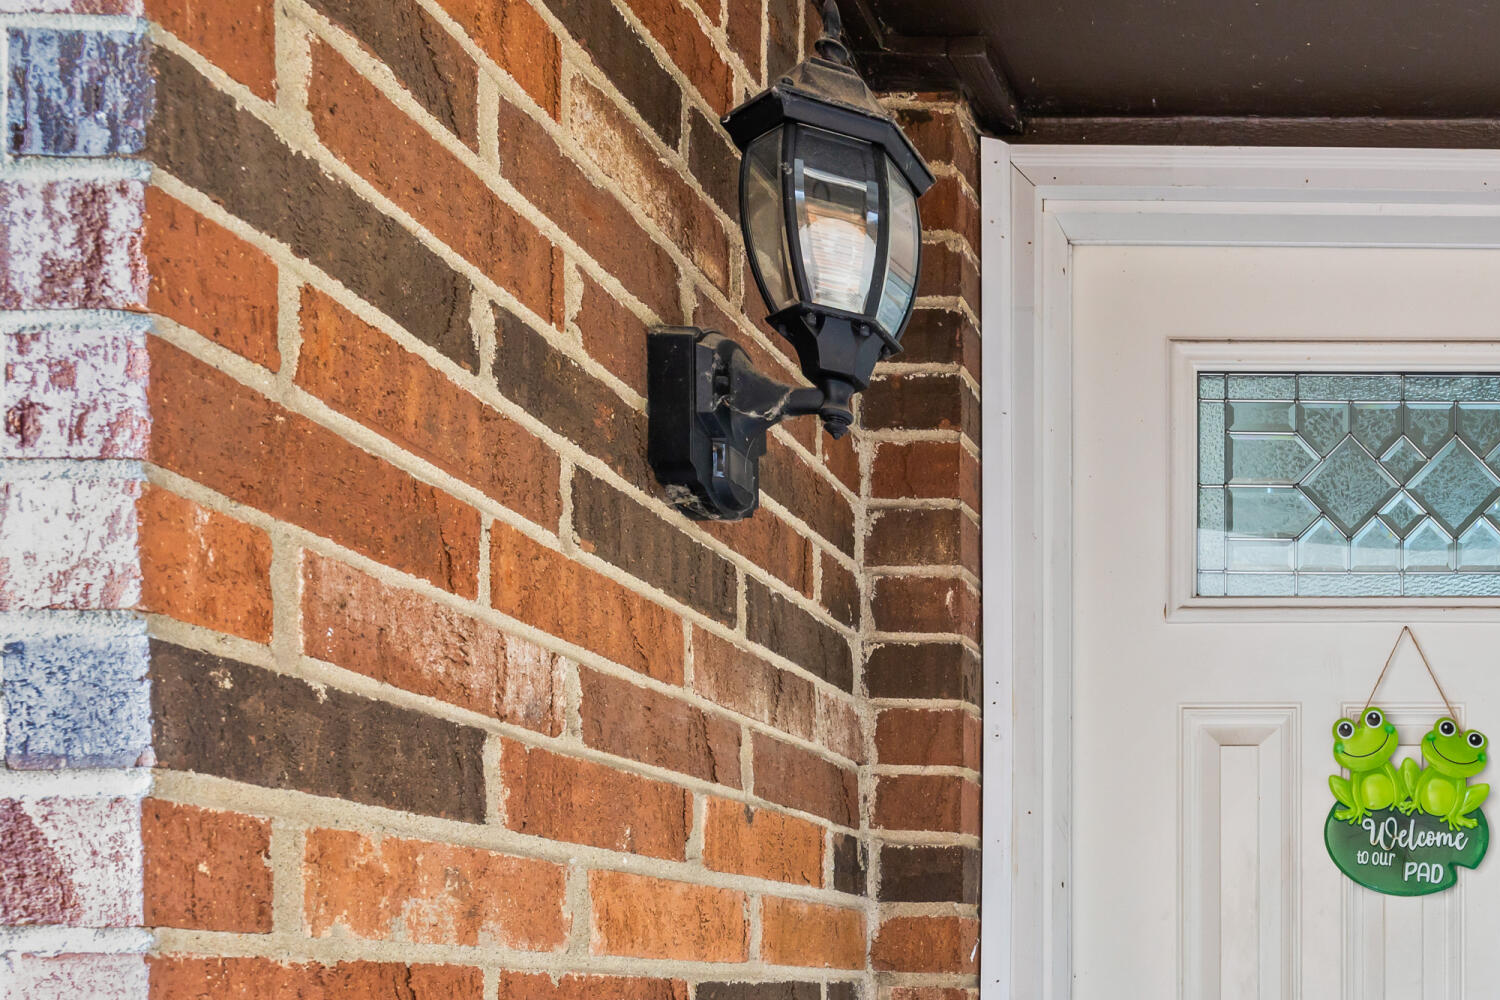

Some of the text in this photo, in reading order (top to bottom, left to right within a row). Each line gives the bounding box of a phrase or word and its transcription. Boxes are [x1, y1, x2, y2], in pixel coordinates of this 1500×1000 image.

[1362, 817, 1468, 850] Welcome
[1357, 850, 1396, 866] to our
[1404, 862, 1444, 884] PAD
